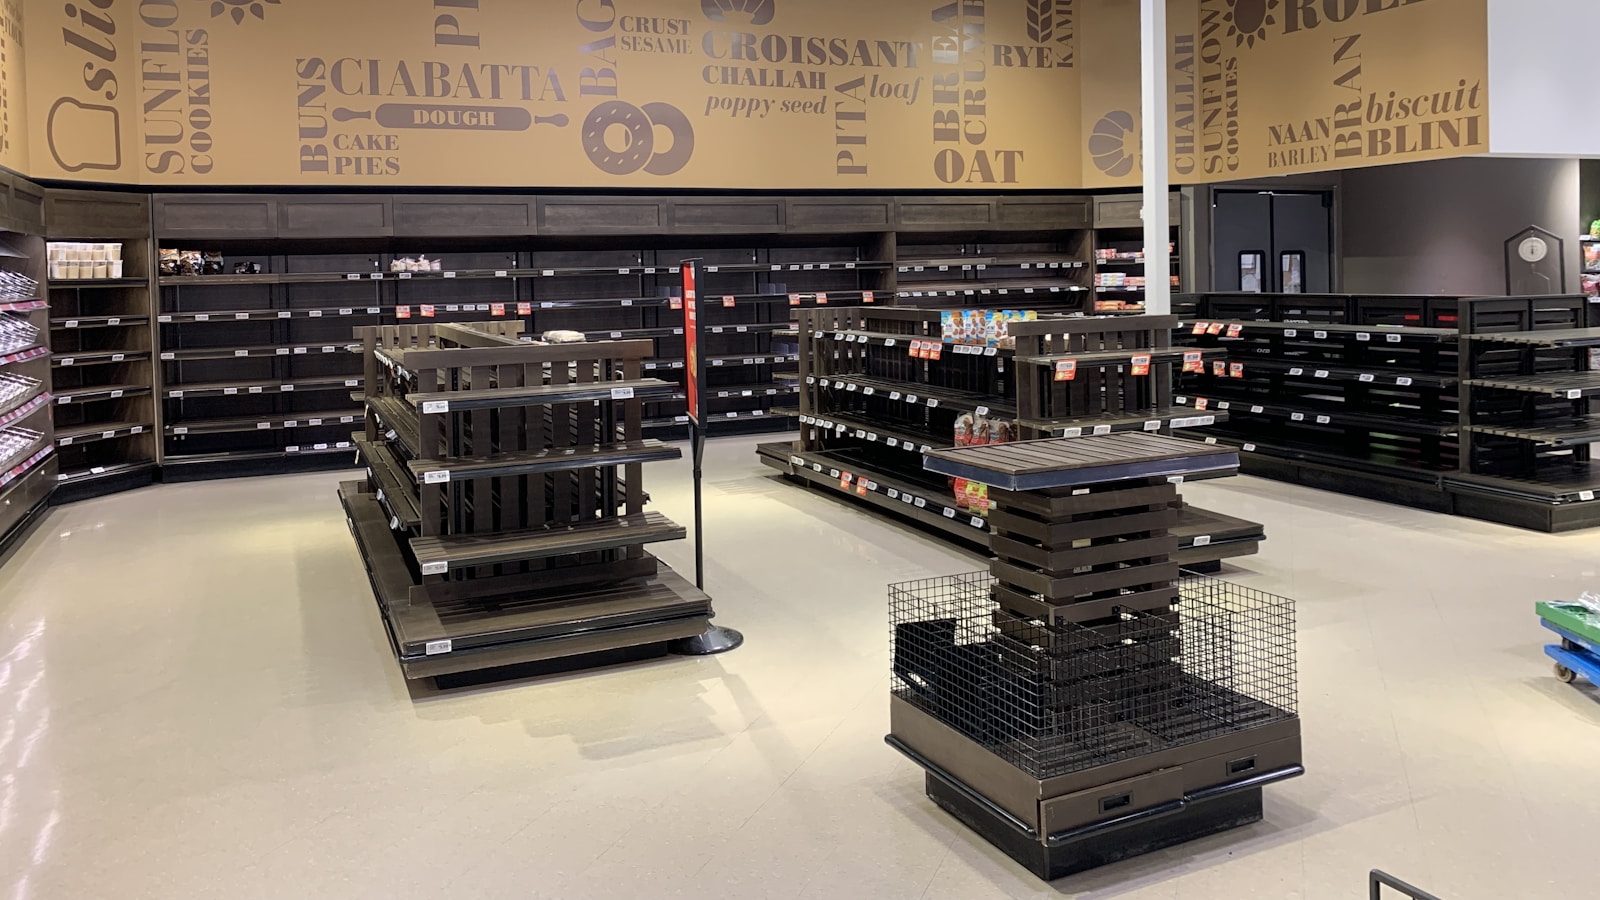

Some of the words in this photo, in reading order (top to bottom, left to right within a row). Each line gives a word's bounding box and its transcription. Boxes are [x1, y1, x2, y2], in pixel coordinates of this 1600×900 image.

[619, 15, 692, 36] CRUST
[62, 0, 119, 100] sli
[620, 35, 693, 55] SESAME
[702, 29, 924, 70] CROISSANT
[992, 44, 1053, 69] RYE
[331, 57, 569, 101] CIABATTA
[702, 65, 827, 90] CHALLAH
[869, 74, 924, 105] loaf
[185, 28, 214, 174] COOKIES
[704, 94, 775, 118] poppy
[780, 95, 827, 115] seed
[1175, 33, 1195, 175] CHALLAH
[1226, 56, 1240, 171] COOKIES
[1333, 33, 1362, 160] BRAN
[1366, 78, 1482, 124] biscuit
[296, 57, 329, 175] BUNS
[413, 109, 496, 127] DOUGH
[834, 74, 868, 176] PITA
[1267, 117, 1331, 147] NAAN
[332, 133, 399, 151] CAKE
[1366, 115, 1482, 158] BLINI
[333, 156, 400, 175] PIES
[934, 148, 1024, 184] OAT
[1268, 143, 1331, 168] BARLEY
